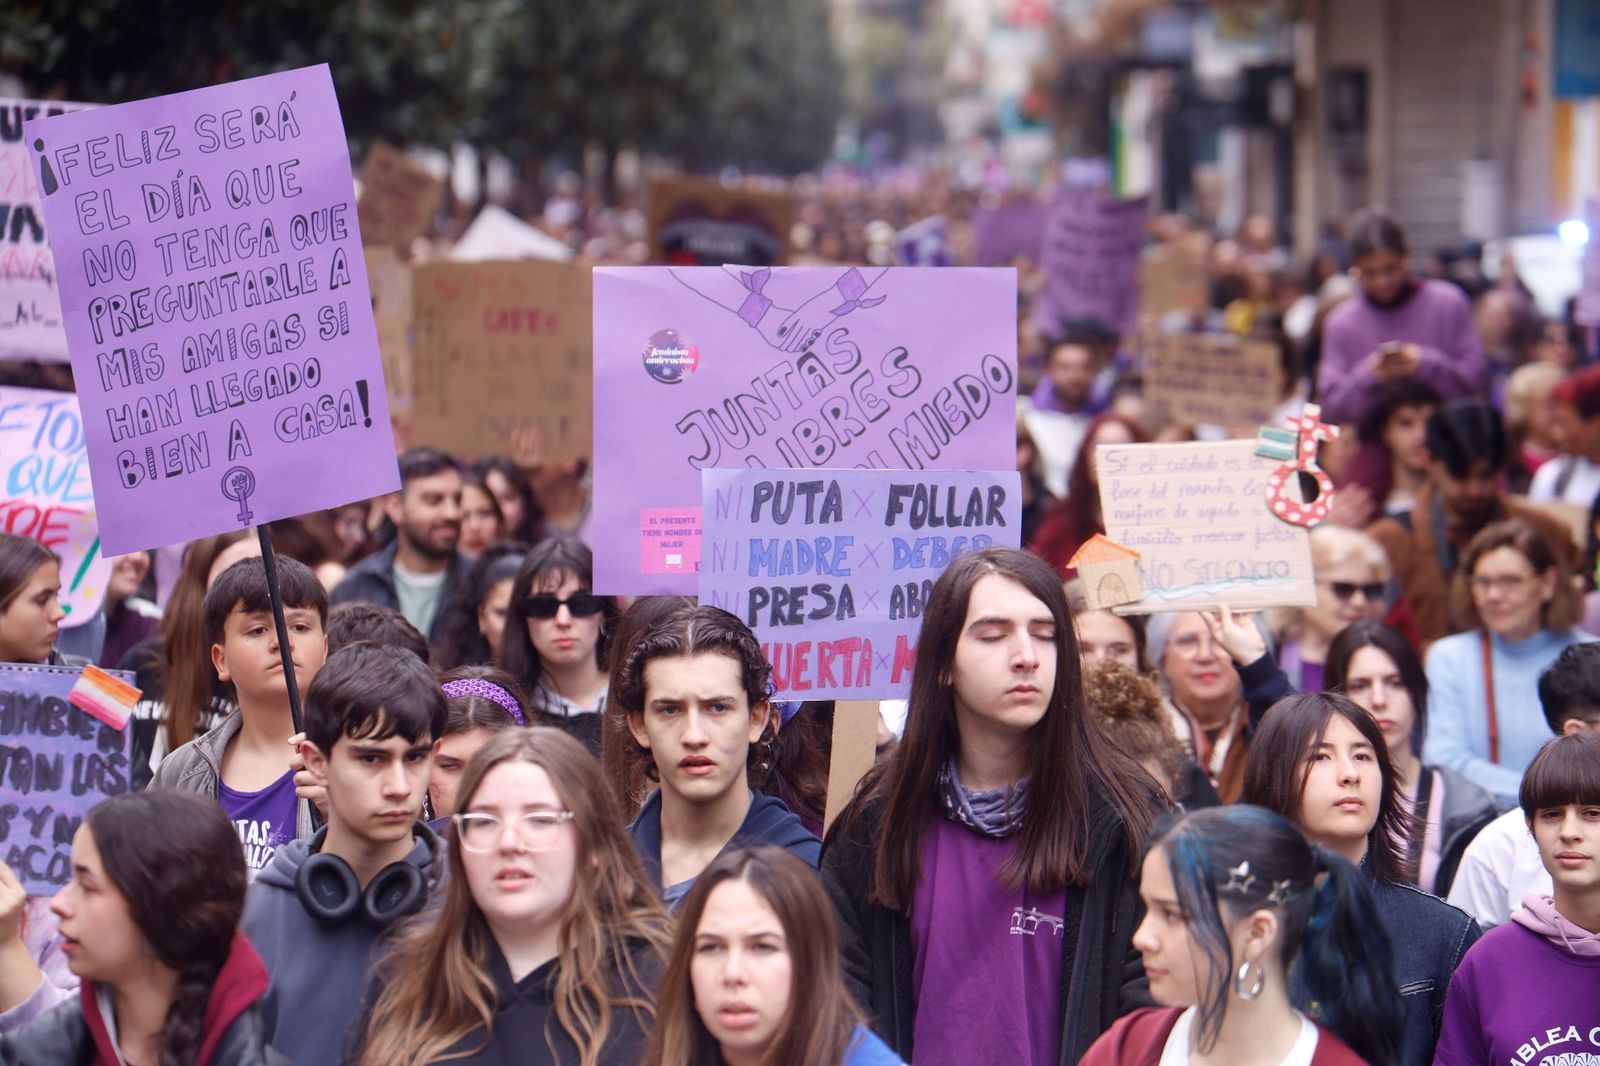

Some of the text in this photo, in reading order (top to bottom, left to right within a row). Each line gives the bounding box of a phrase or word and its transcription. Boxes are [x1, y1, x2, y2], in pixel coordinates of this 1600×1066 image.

[34, 125, 180, 195] ¡FELIZ
[194, 91, 301, 154] SERÁ
[75, 158, 302, 235] EL DÍA QUE
[83, 239, 137, 287] NO
[154, 218, 281, 277] TENGA
[289, 202, 348, 251] QUE
[88, 256, 319, 345] PREGUNTARLE
[329, 247, 352, 291] A
[96, 301, 349, 392] MIS AMIGAS SI
[106, 357, 322, 443] HAN LLEGADO
[116, 378, 373, 490] BIEN A CASA!
[675, 327, 863, 470] JUNTAS
[745, 346, 923, 469] IBRES
[888, 353, 1014, 471] MIEDO
[715, 482, 744, 521] NI
[750, 479, 844, 526] PUTA
[885, 482, 1007, 531] FOLLAR
[712, 537, 739, 574] NI
[748, 535, 855, 578] MADRE
[748, 583, 857, 628] PRESA
[761, 636, 873, 693] UERTA
[71, 752, 128, 797] LAS
[232, 819, 271, 846] TAS
